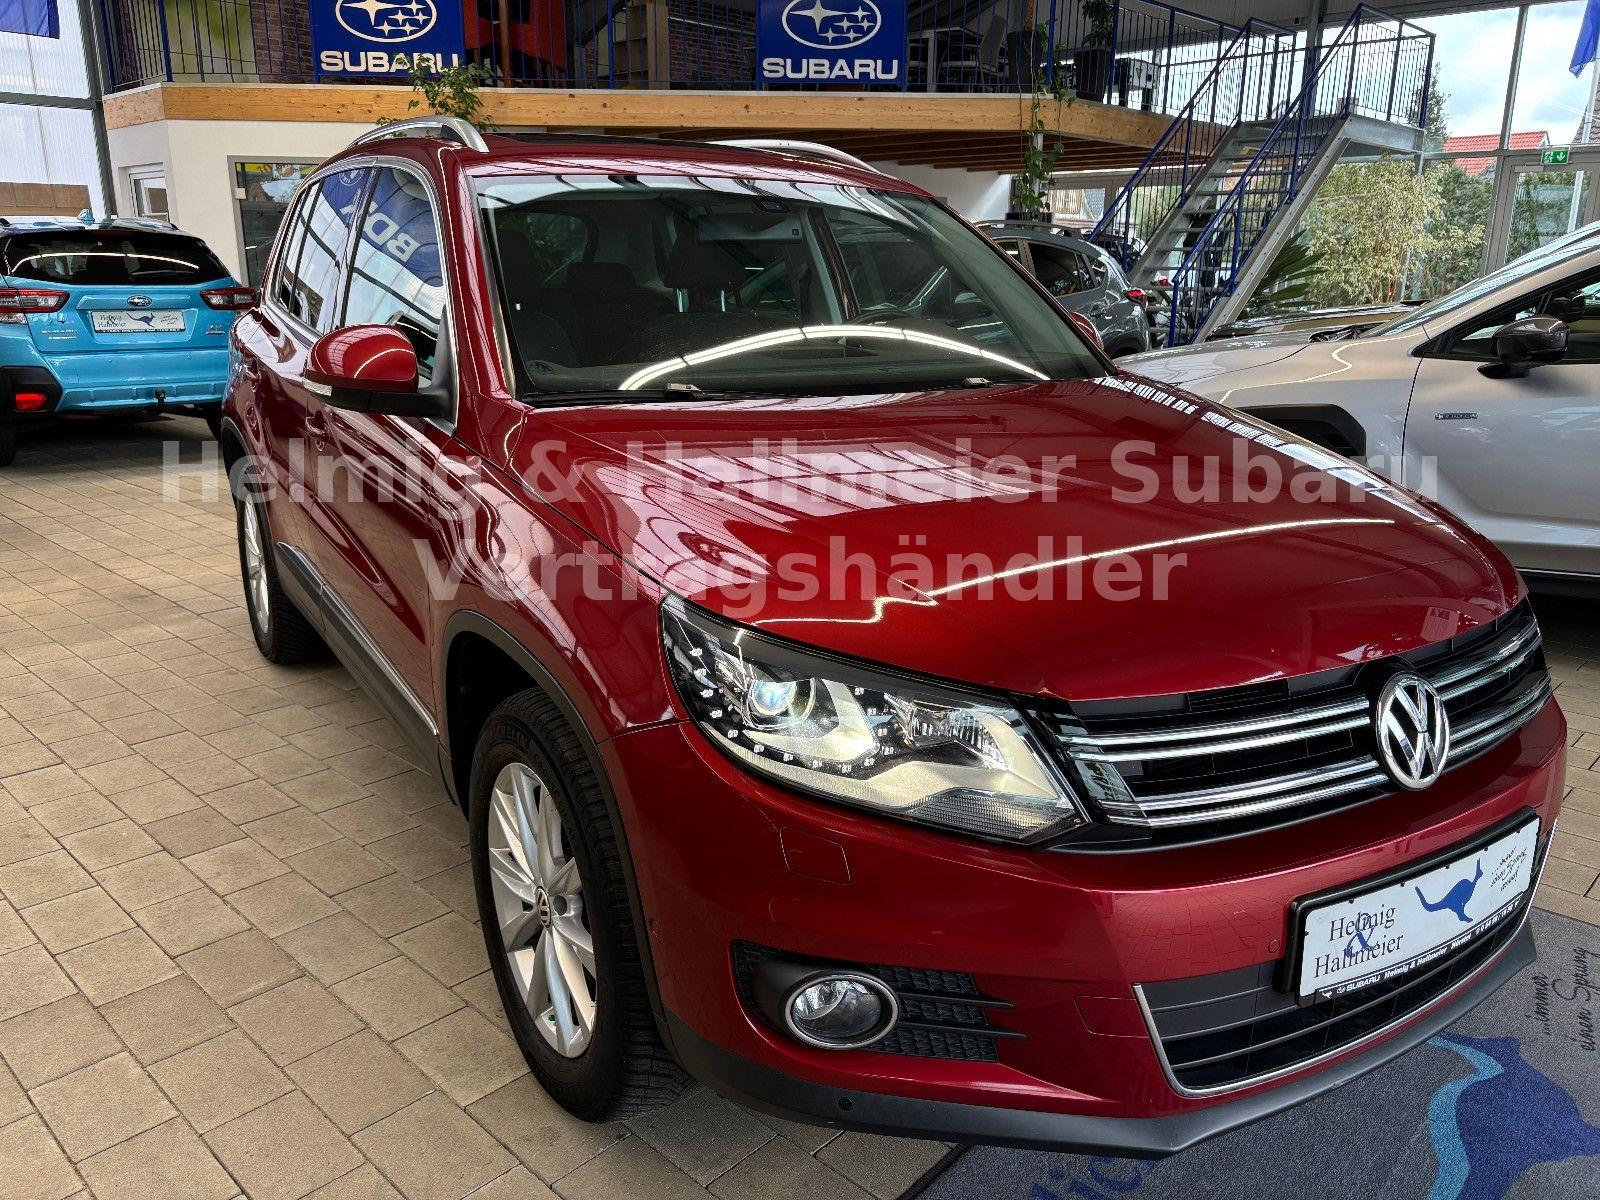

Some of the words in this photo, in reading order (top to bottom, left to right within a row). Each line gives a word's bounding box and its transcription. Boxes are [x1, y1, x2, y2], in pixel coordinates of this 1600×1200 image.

[320, 51, 459, 74] SUBARU
[762, 57, 898, 80] SUBARU
[1328, 904, 1396, 943] Helmig
[1313, 935, 1404, 979] Hallmeier
[1346, 975, 1380, 992] SUBARU
